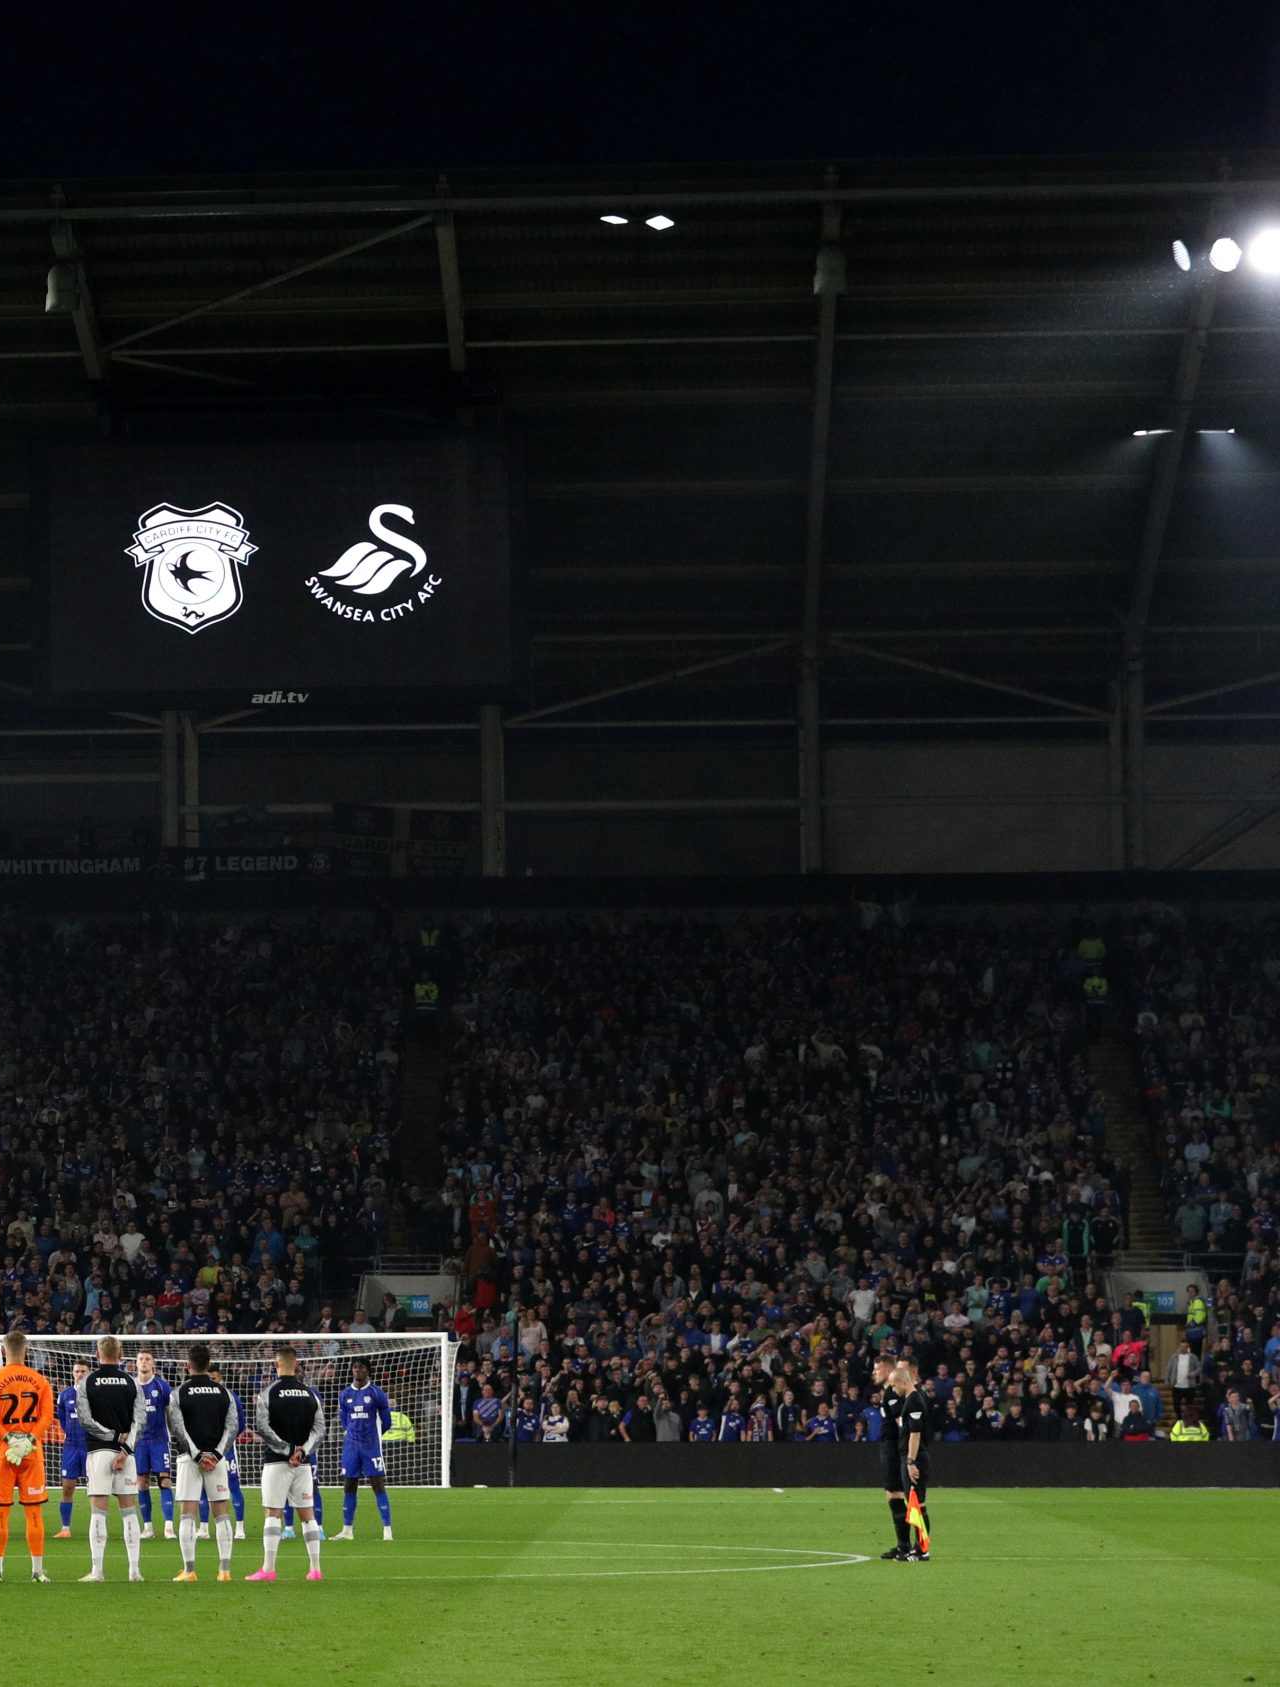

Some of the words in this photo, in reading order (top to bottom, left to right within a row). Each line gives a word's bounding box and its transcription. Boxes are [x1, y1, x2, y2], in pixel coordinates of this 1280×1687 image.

[144, 525, 193, 544] CARDIFF
[196, 525, 222, 537] CITY
[224, 531, 239, 543] FC
[305, 576, 375, 622] SWANSEA
[380, 599, 414, 621] CITY
[417, 574, 442, 604] AFC
[251, 690, 310, 704] adi.tv
[184, 856, 208, 871] #7
[215, 856, 298, 871] LEGEND
[412, 1300, 429, 1309] 106
[1158, 1297, 1174, 1307] 107
[0, 1392, 39, 1425] 22
[163, 1453, 170, 1464] 5
